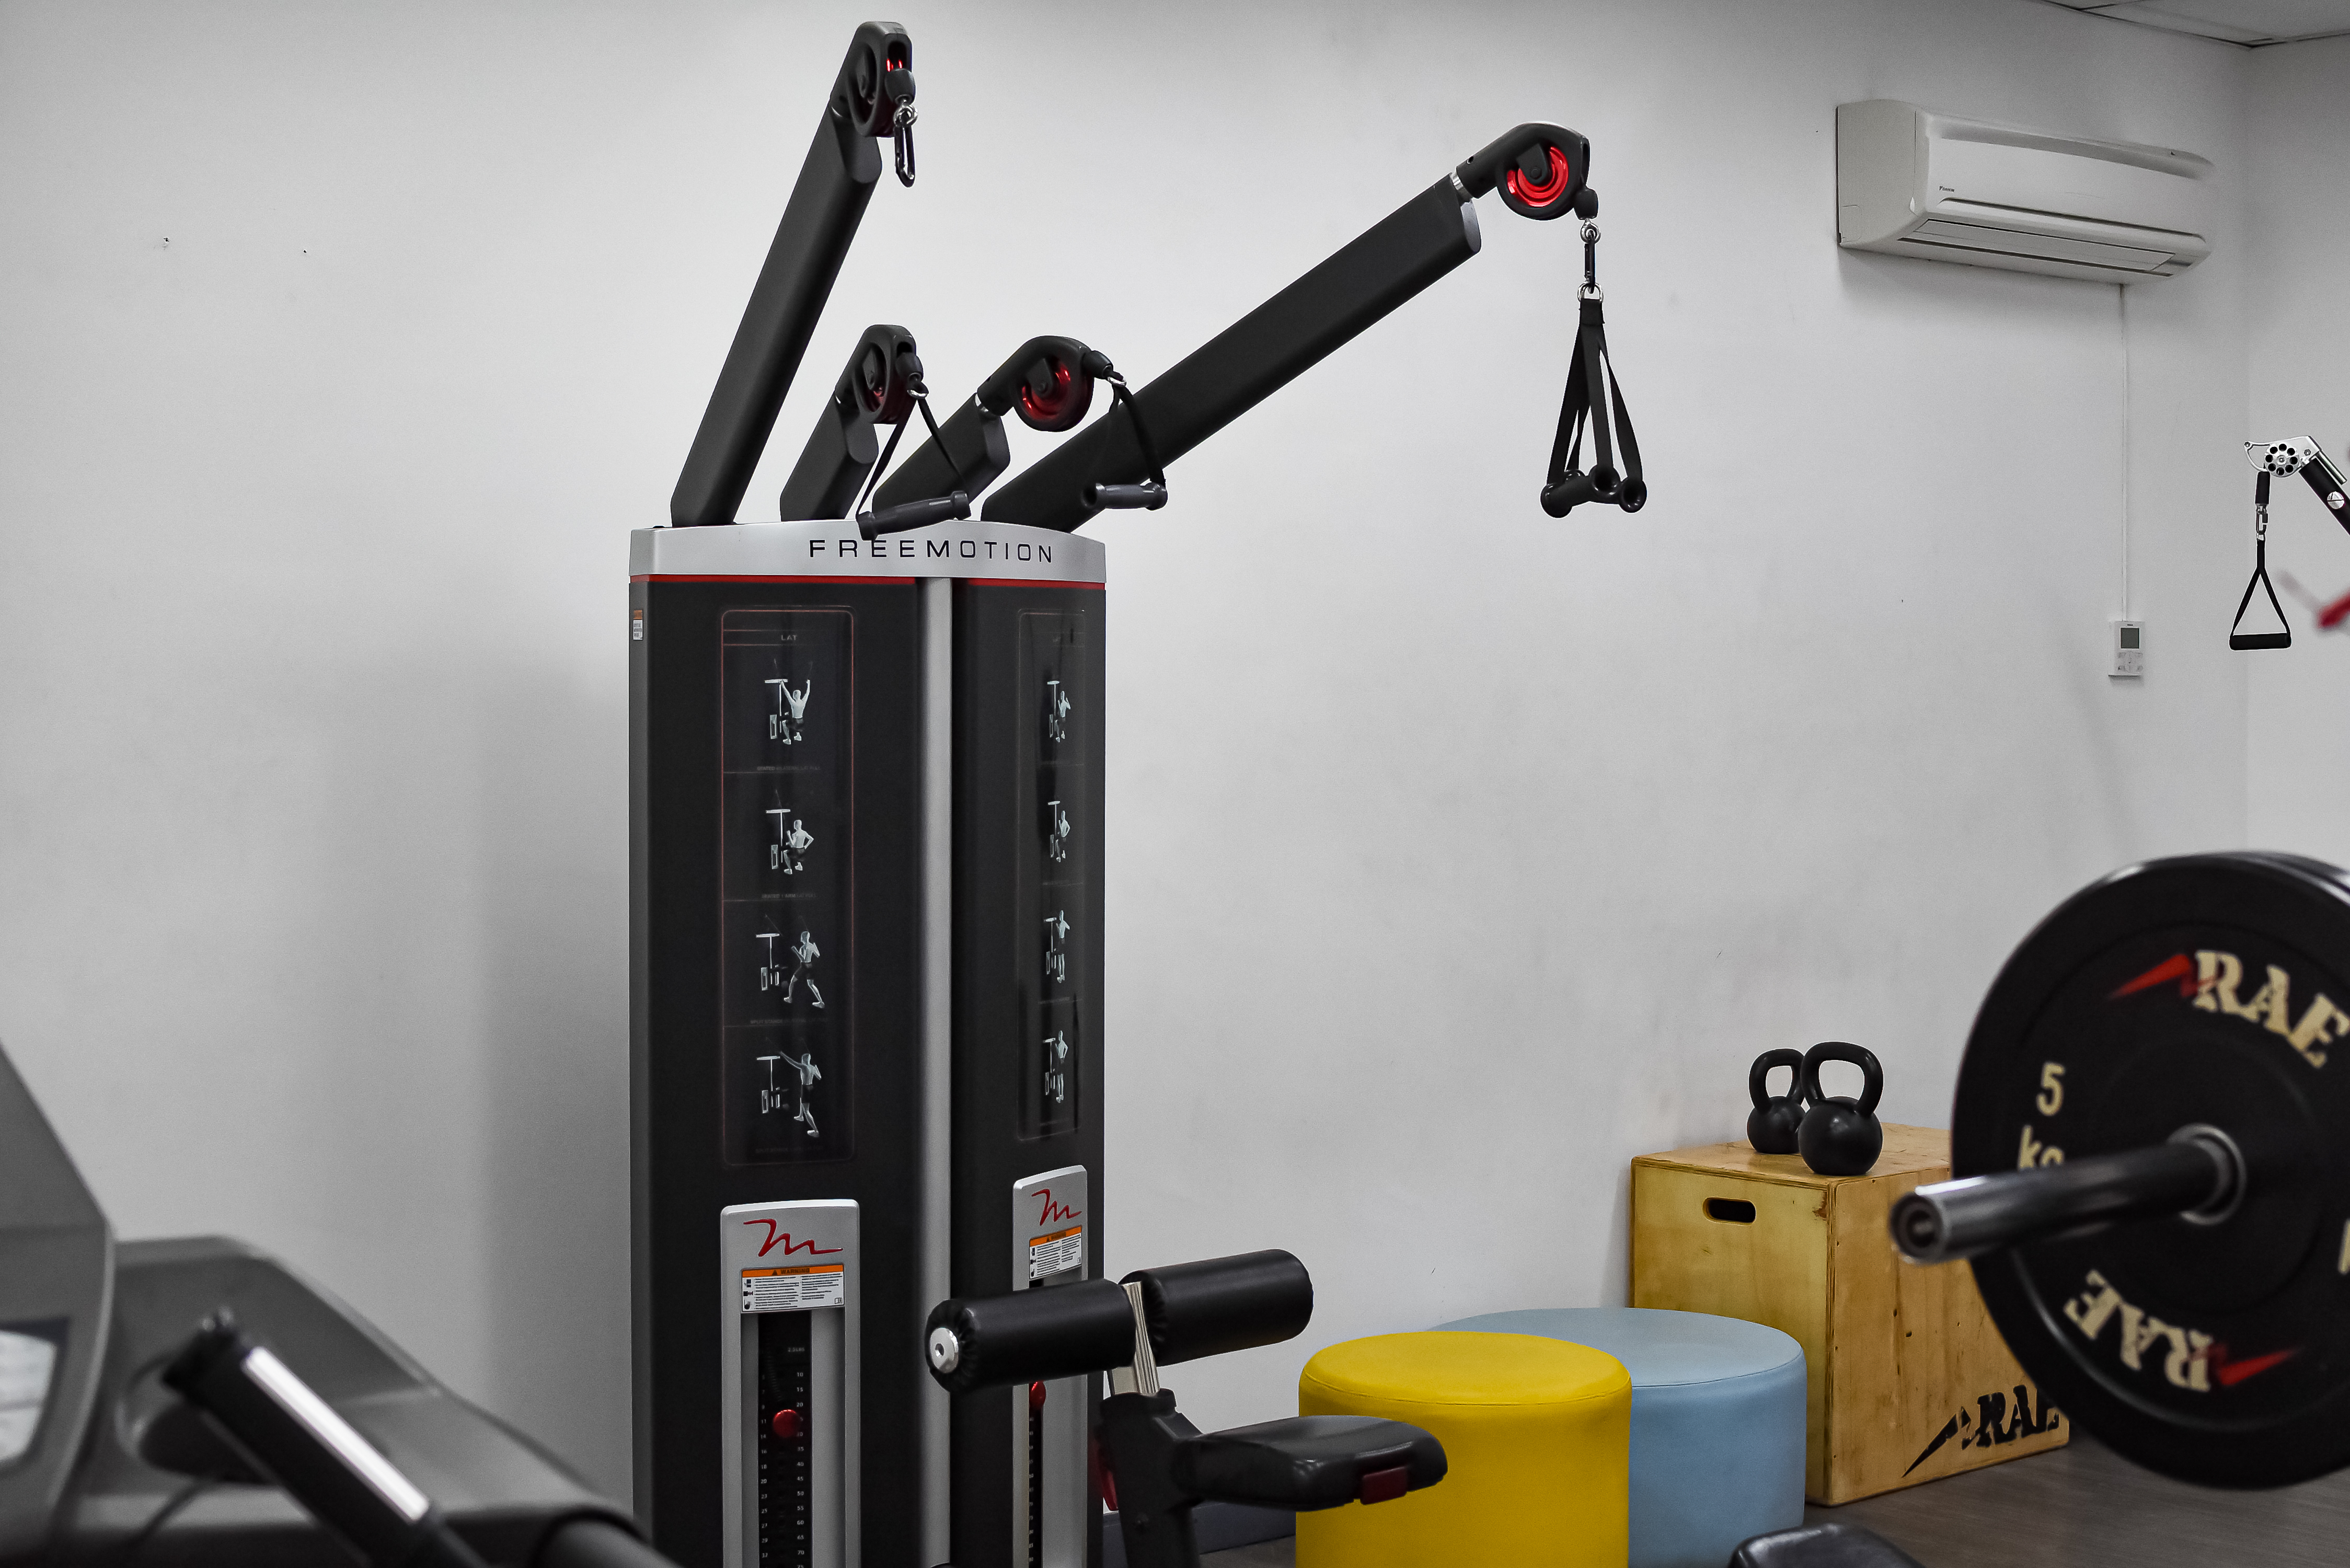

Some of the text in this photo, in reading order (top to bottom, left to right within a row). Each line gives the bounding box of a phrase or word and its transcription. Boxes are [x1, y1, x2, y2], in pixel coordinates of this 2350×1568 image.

[809, 539, 1053, 563] FREEMOTION
[2192, 949, 2350, 1069] RAE
[2035, 1061, 2066, 1117] 5
[2063, 1269, 2213, 1392] RAE
